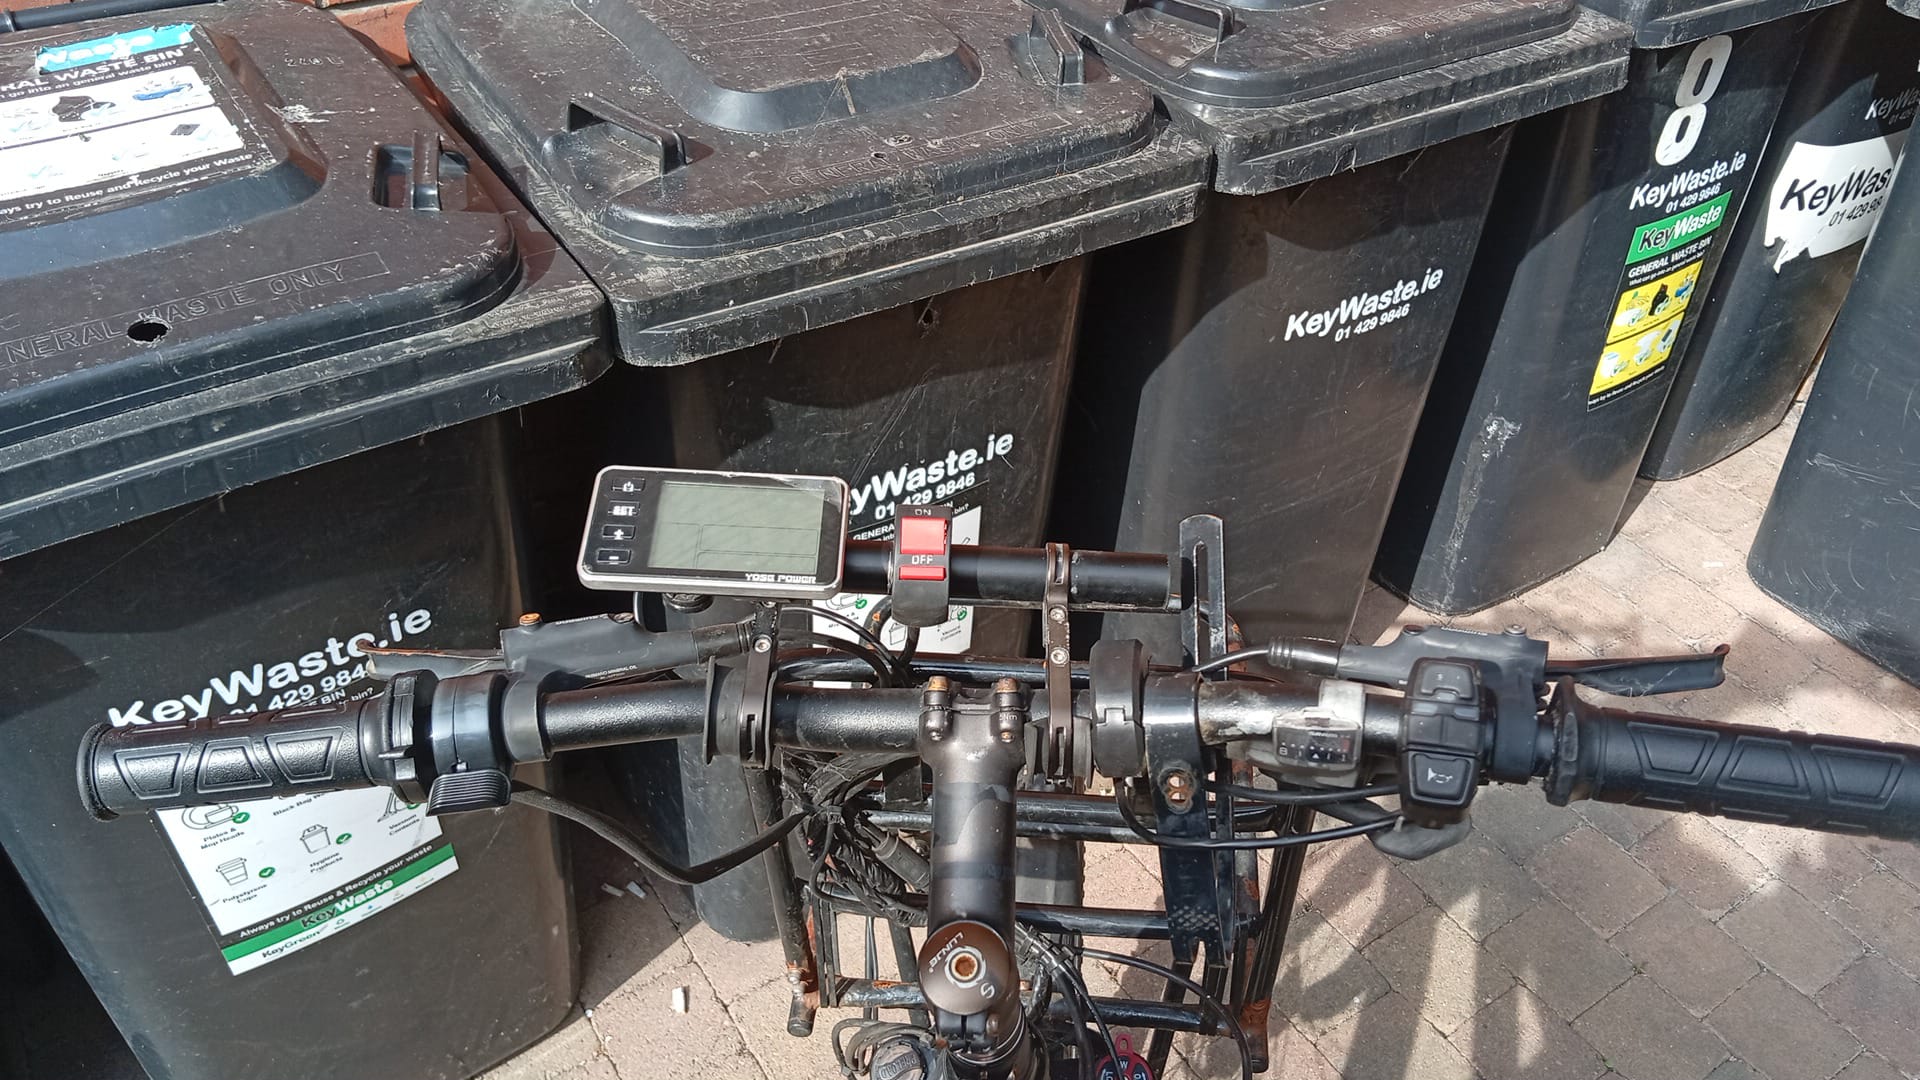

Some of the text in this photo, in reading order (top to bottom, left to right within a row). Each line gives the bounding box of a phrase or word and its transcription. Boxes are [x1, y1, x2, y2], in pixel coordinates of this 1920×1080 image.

[28, 86, 51, 94] into
[74, 73, 115, 86] general
[118, 65, 151, 76] waste
[54, 49, 184, 81] WASTE BIN
[0, 205, 22, 215] ays
[25, 200, 43, 211] try
[47, 197, 62, 205] to
[65, 189, 104, 202] Reuse
[107, 182, 131, 193] and
[135, 170, 180, 187] Recycle
[183, 163, 211, 175] your
[213, 153, 253, 167] Waste
[1629, 151, 1747, 210] KeyWaste.ie
[1665, 200, 1679, 213] 01
[1680, 192, 1698, 208] 429
[1828, 209, 1847, 226] 01
[1638, 205, 1722, 253] KeyWaste
[1628, 256, 1669, 278] GENERAL
[1671, 243, 1698, 262] WASTE
[0, 320, 122, 366] NERAL
[269, 262, 346, 296] ONLY
[1284, 267, 1443, 341] KeyWaste.ie
[1335, 303, 1411, 342] 01 429 9846
[850, 433, 1014, 516] yWaste.ie
[613, 505, 635, 516] SET
[875, 502, 896, 520] 01
[936, 472, 976, 499] 9846
[914, 508, 932, 516] ON
[853, 523, 895, 541] GENERA
[911, 554, 933, 565] OFF
[745, 573, 816, 584] YOSE POWER
[108, 609, 432, 727] KeyWaste.ie
[268, 684, 315, 711] 429
[320, 663, 368, 692] 984
[321, 689, 346, 705] BIN
[351, 687, 374, 702] bin?
[240, 920, 275, 938] Always
[275, 914, 290, 926] try
[292, 908, 303, 917] to
[304, 894, 335, 911] Reuse
[346, 871, 383, 891] Recycle
[384, 859, 405, 875] your
[406, 844, 433, 864] waste
[301, 879, 394, 929] KeyWaste
[262, 930, 320, 958] KeyGreen
